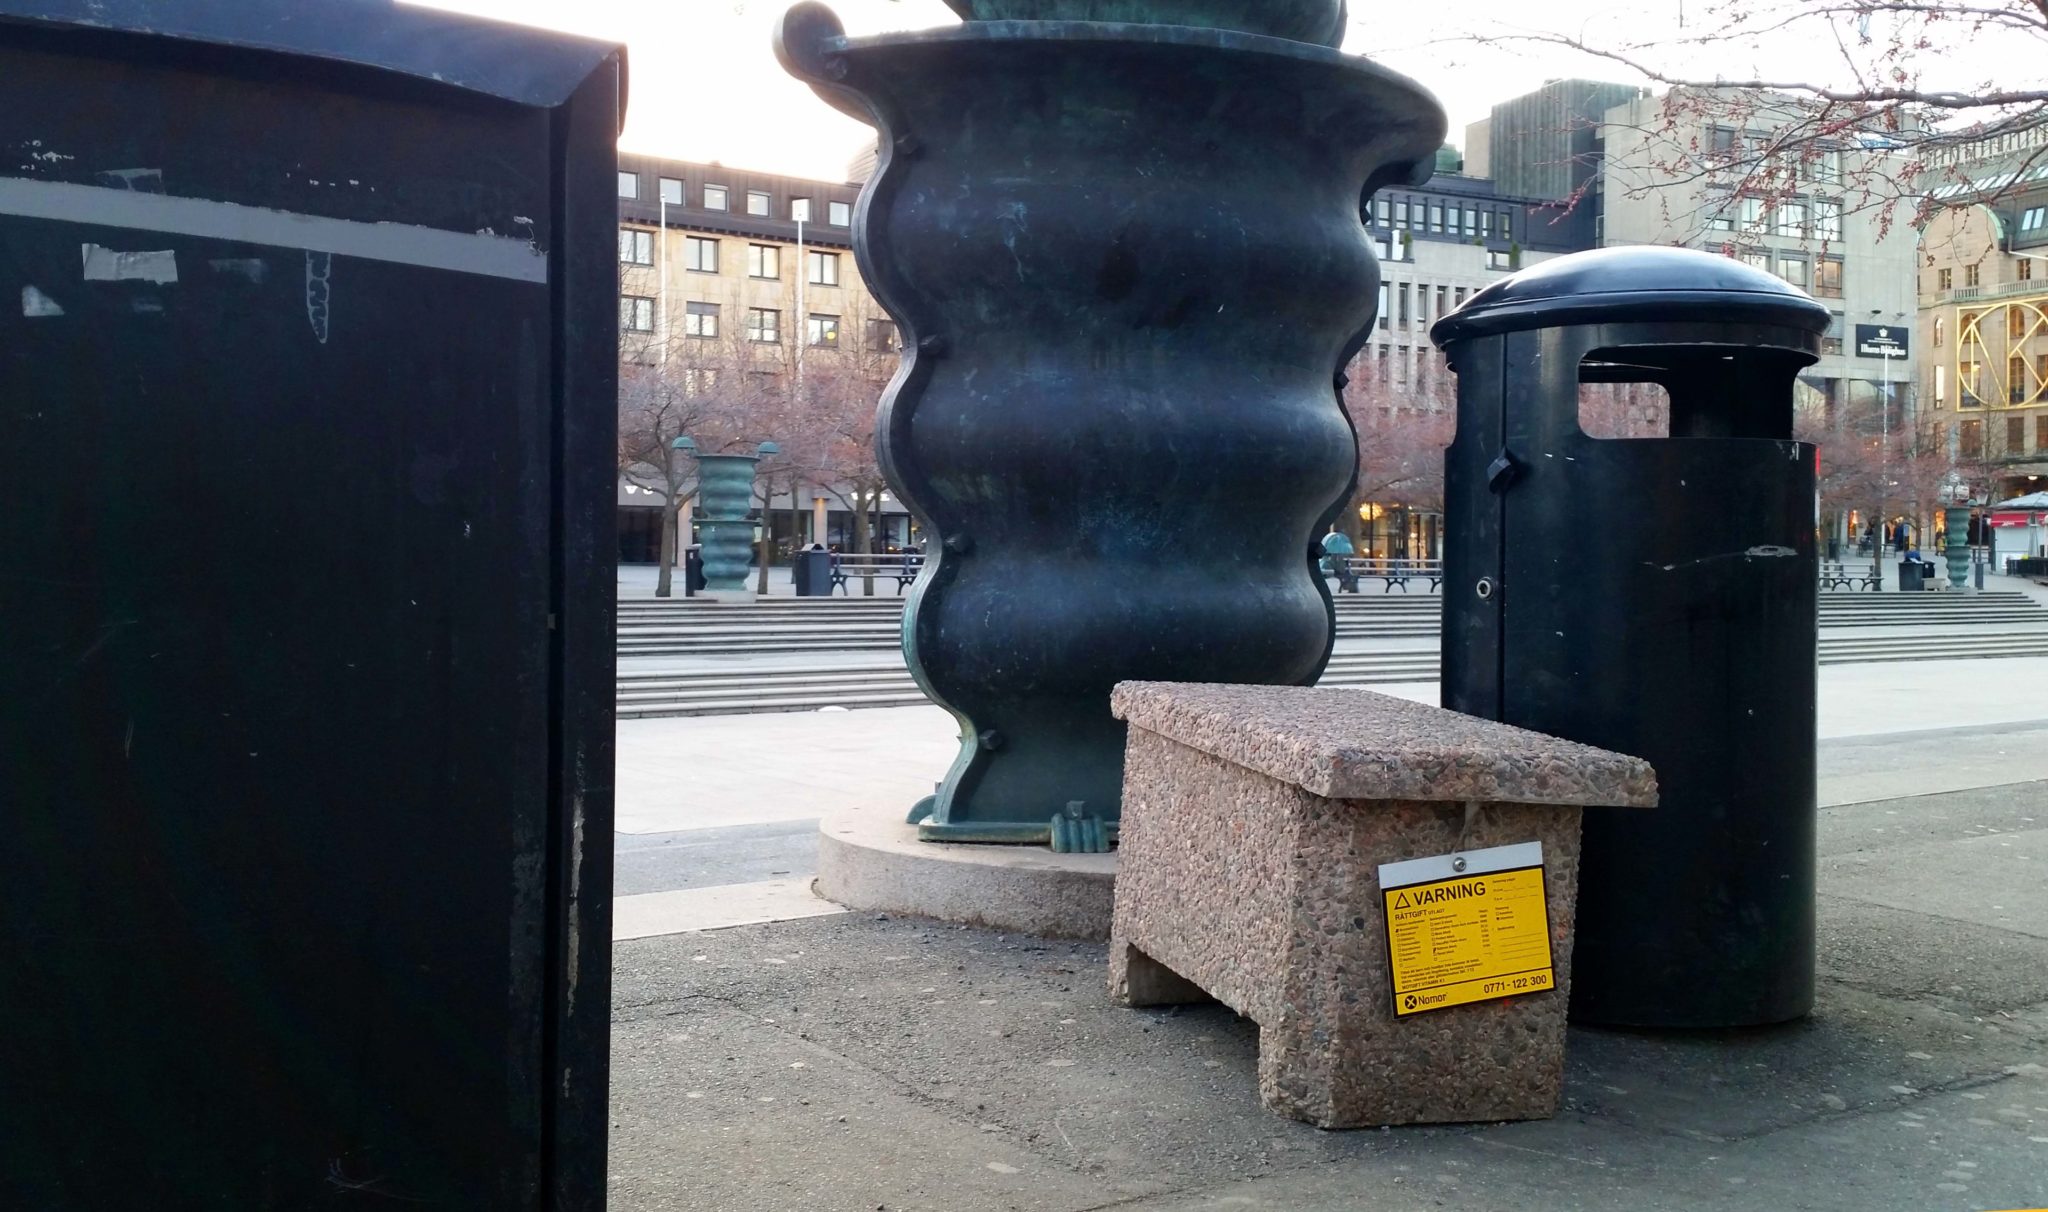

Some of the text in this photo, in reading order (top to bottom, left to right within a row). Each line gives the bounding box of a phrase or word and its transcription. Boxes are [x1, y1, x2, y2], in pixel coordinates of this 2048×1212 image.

[1414, 881, 1486, 906] VARNING
[1395, 908, 1428, 921] RÅTTGIFT
[1530, 974, 1547, 986] 300
[1418, 993, 1447, 1005] Nomor
